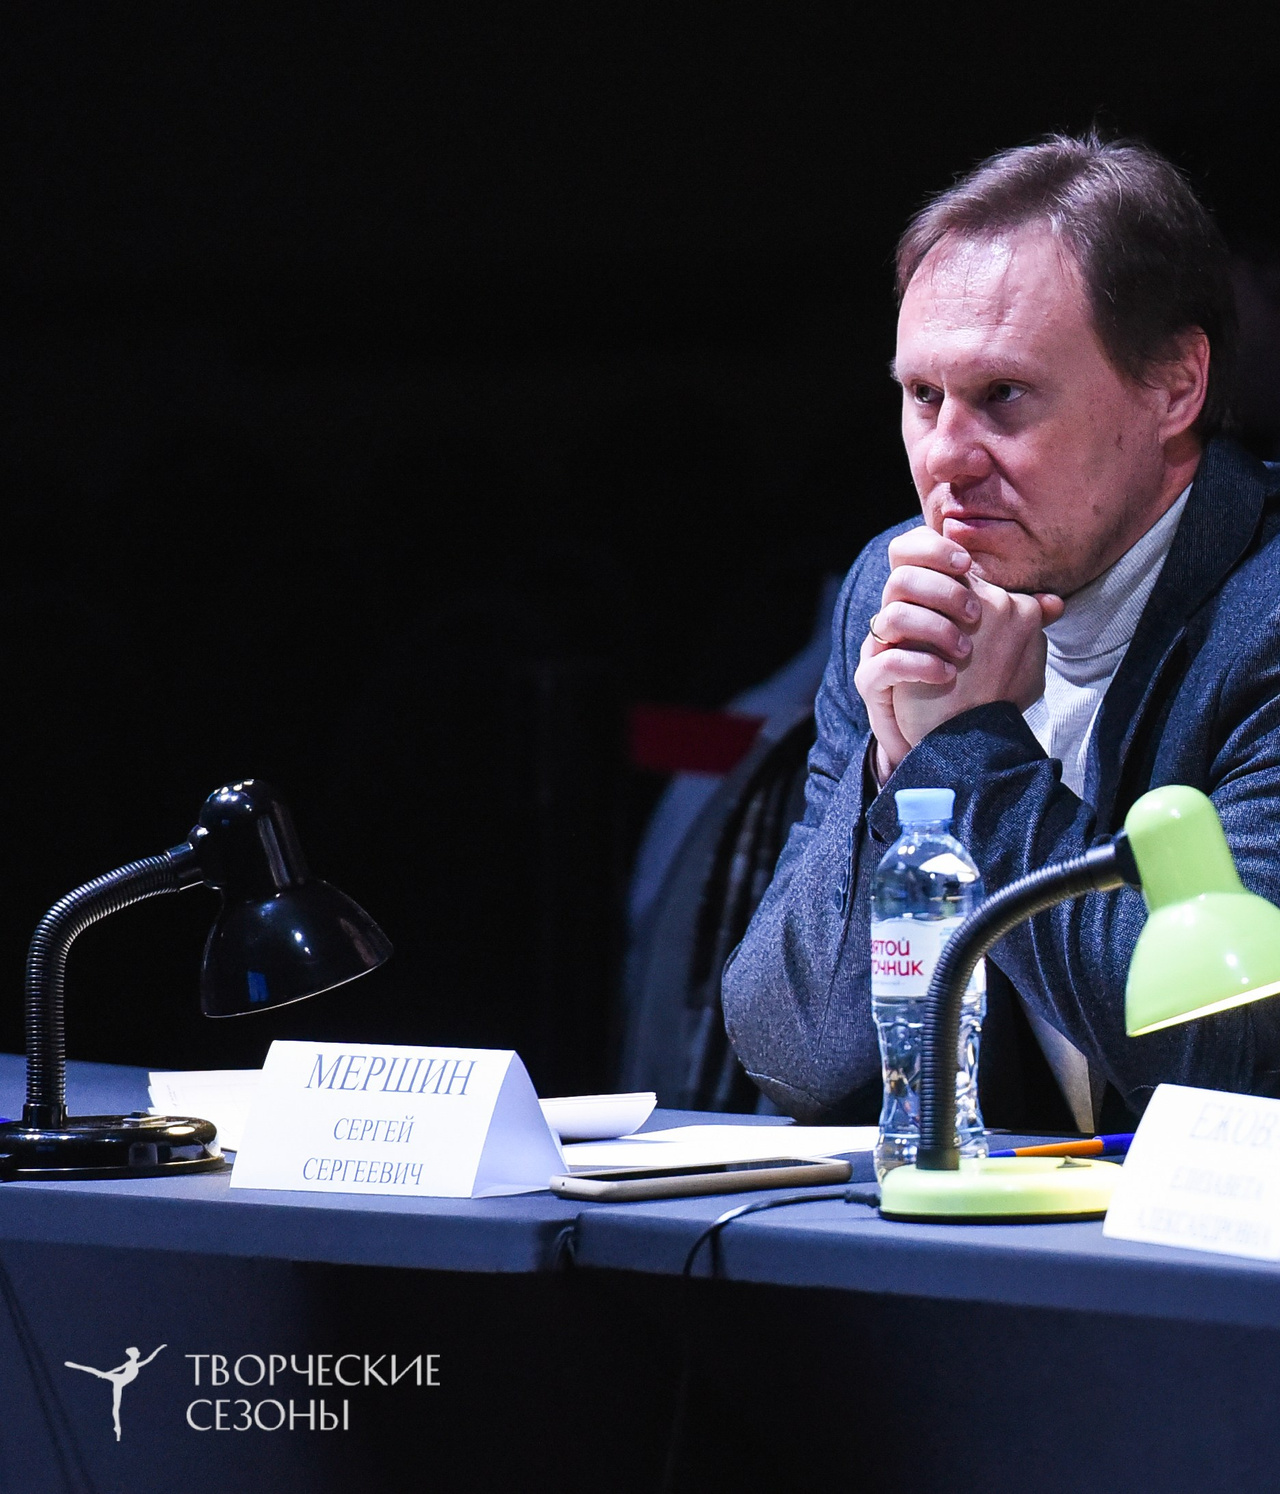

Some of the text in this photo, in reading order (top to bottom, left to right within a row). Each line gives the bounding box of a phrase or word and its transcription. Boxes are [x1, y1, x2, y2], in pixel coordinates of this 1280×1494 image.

[304, 1053, 478, 1095] МЕРШИН
[333, 1115, 415, 1143] СЕРГЕЙ
[303, 1158, 424, 1185] СЕРГЕЕВИЧ
